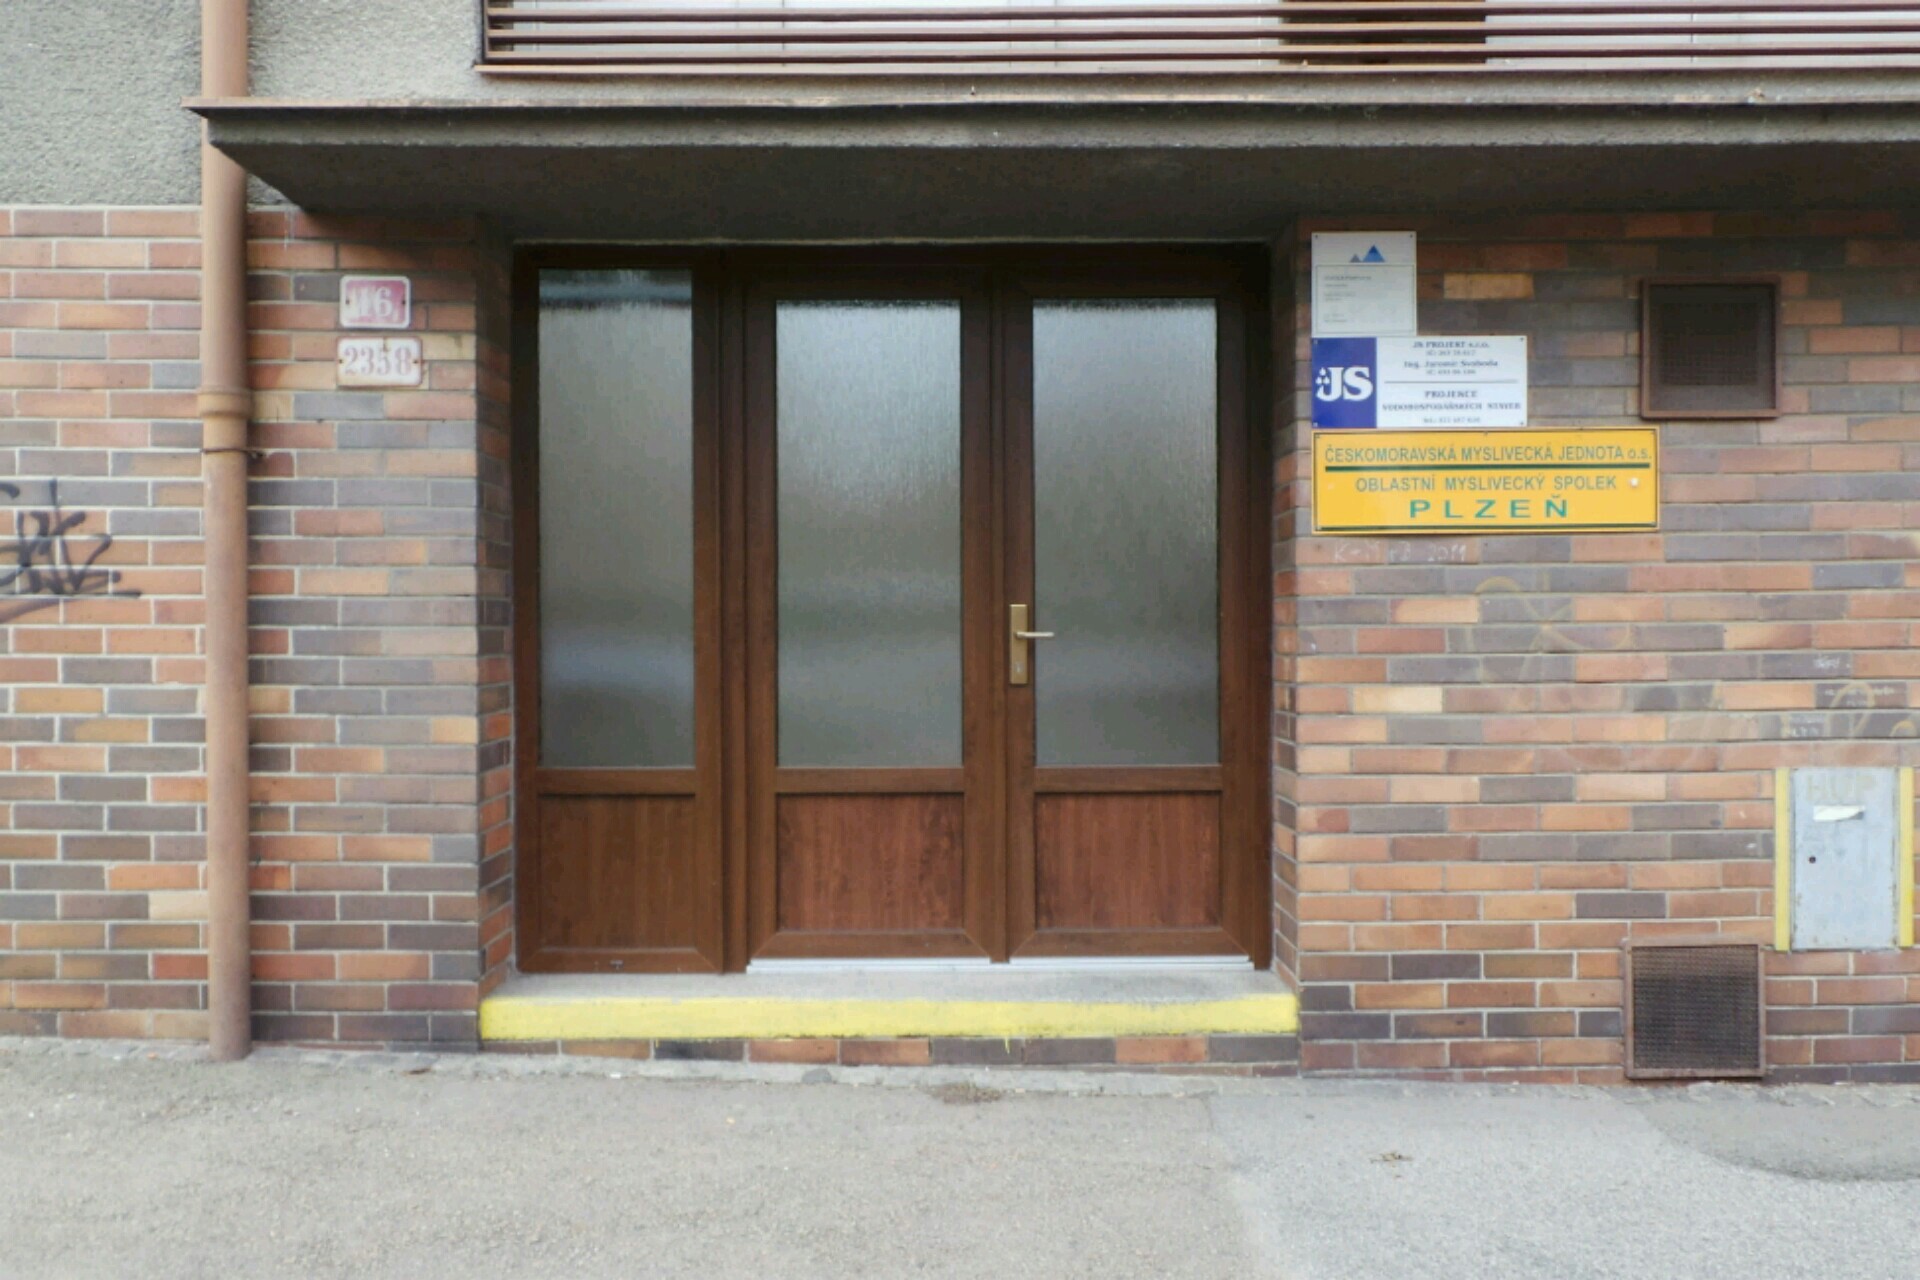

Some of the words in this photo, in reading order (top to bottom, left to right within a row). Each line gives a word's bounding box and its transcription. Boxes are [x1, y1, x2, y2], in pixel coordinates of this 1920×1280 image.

[1315, 366, 1374, 402] JS
[1325, 443, 1457, 463] ČESKOMORAVSKÁ
[1461, 441, 1553, 462] MYSLIVECKÁ
[1558, 445, 1624, 460] JEDNOTA
[1627, 448, 1652, 460] o.s.
[1356, 474, 1435, 492] OBLASTNÍ
[1445, 472, 1545, 491] MYSLIVECKÝ
[1553, 475, 1617, 491] SPOLEK
[1409, 493, 1568, 518] PLZEŇ
